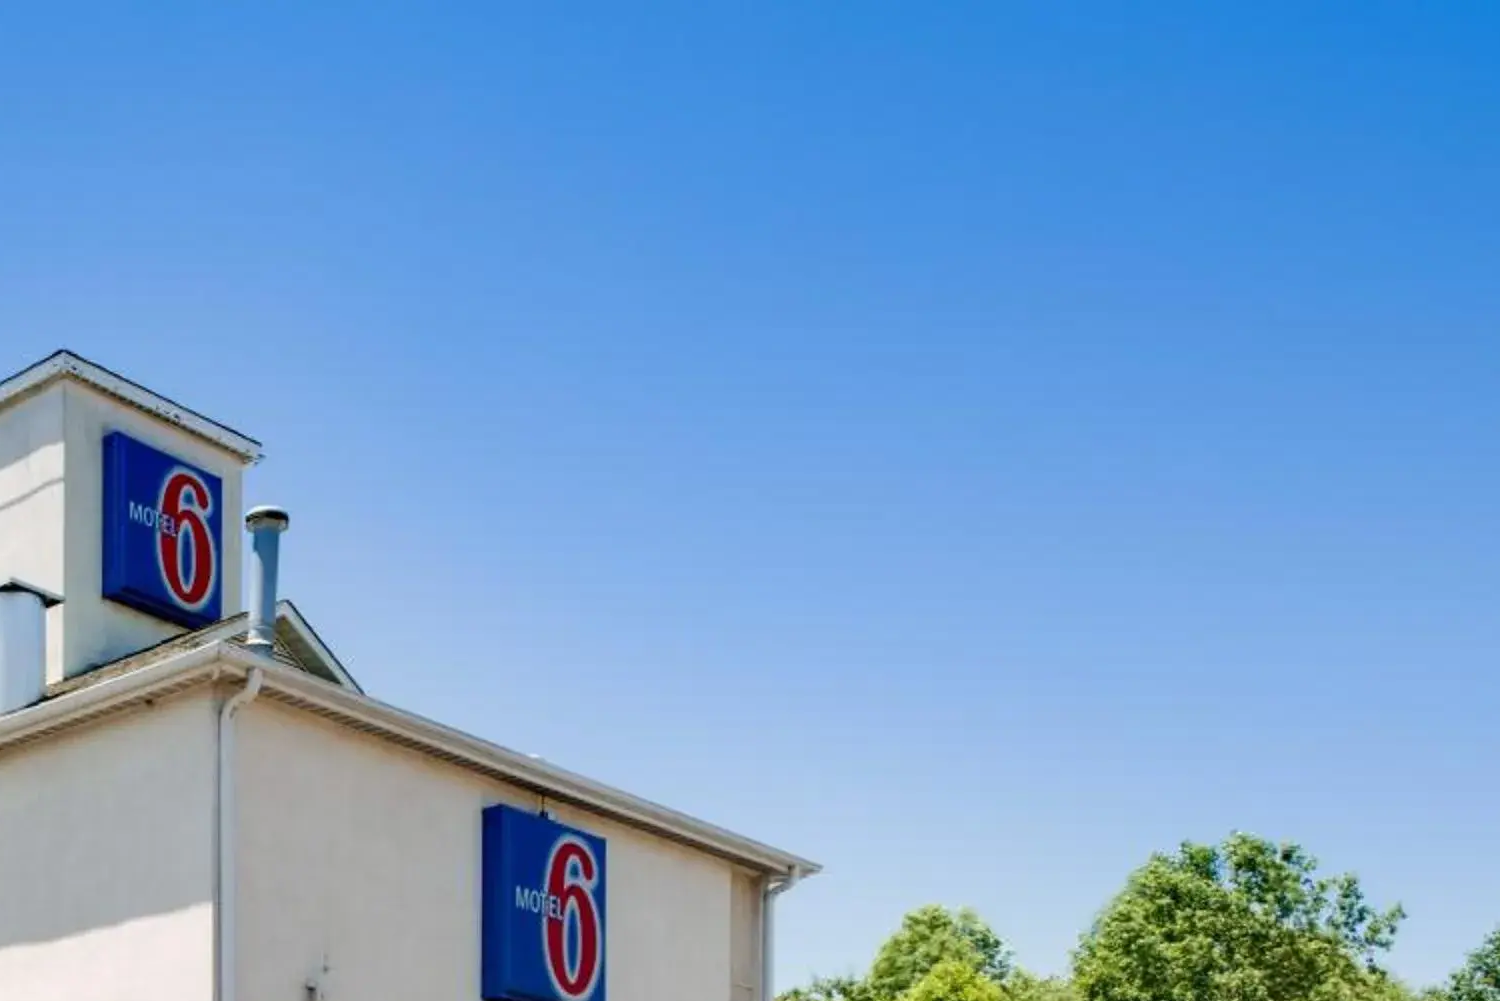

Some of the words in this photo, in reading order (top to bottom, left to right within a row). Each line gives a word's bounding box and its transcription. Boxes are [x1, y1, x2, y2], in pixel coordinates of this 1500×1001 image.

[128, 500, 179, 538] MOTEL
[159, 467, 213, 612] 6
[515, 884, 564, 921] MOTEL
